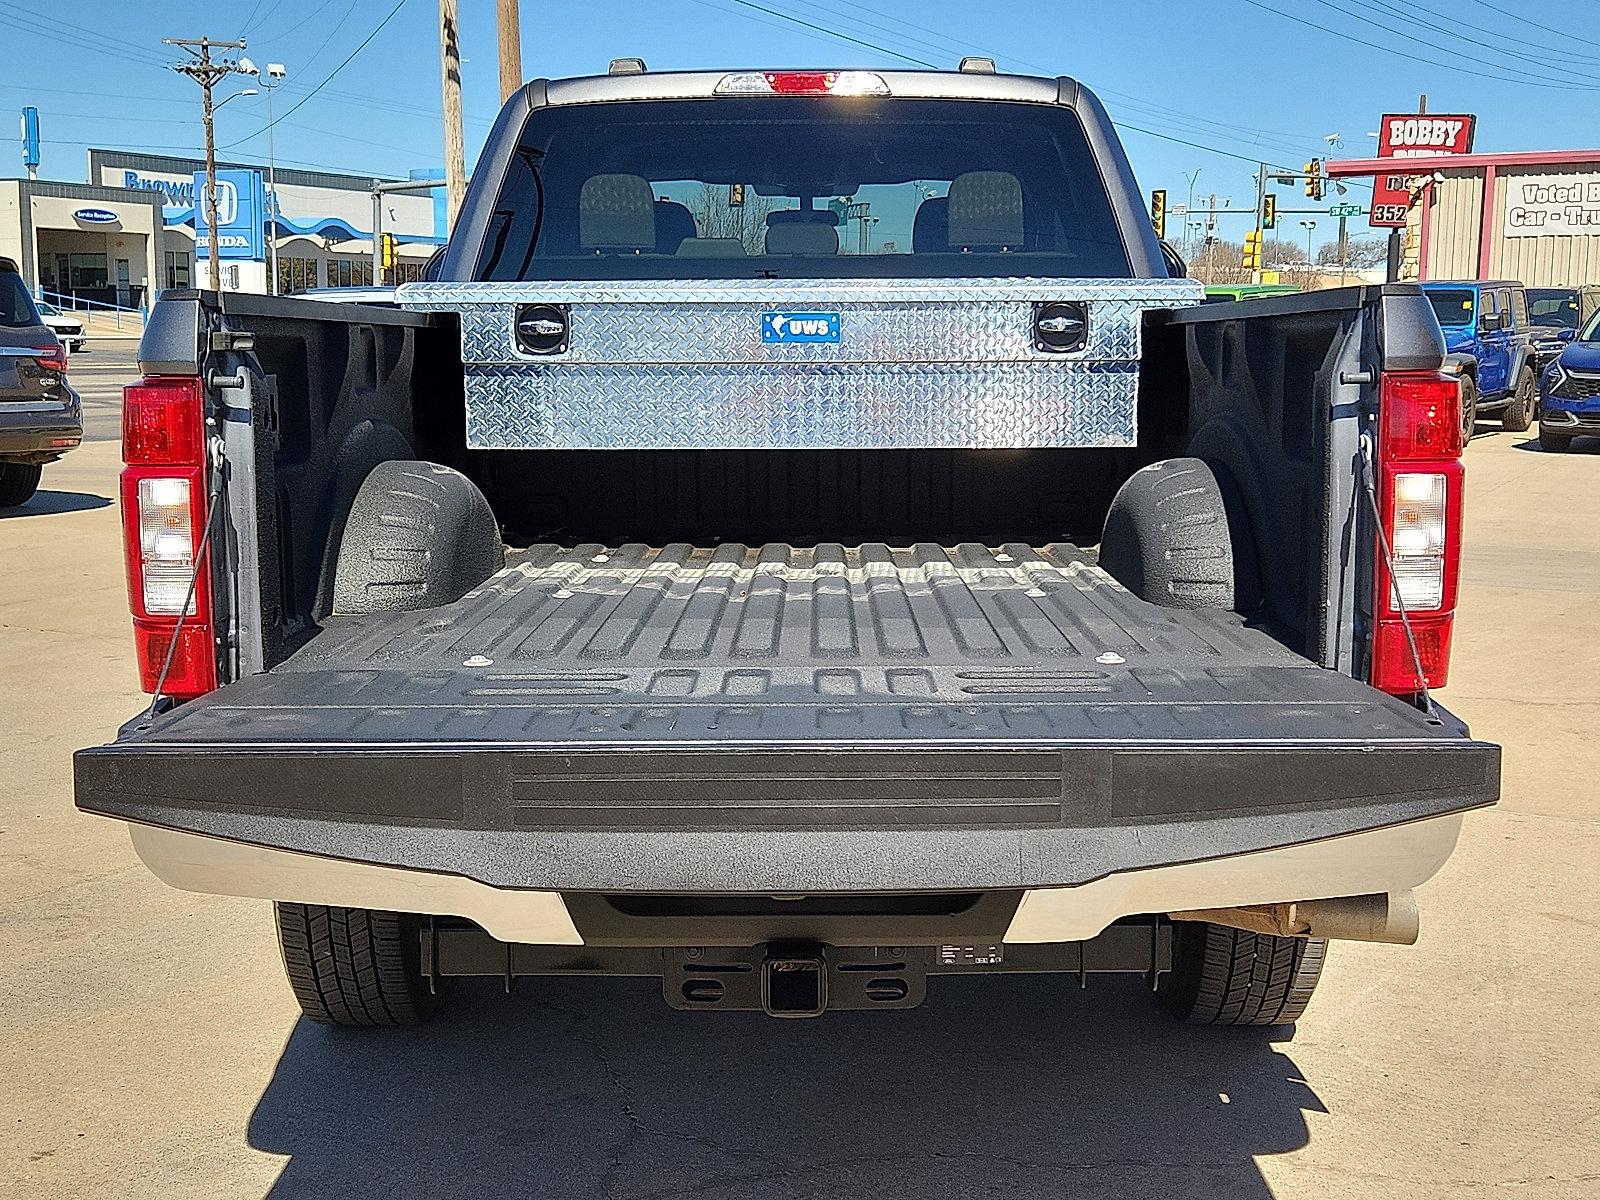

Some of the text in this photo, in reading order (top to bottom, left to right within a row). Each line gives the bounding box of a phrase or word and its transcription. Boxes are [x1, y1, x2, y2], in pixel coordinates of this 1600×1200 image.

[1389, 120, 1463, 147] BOBBY
[1522, 183, 1583, 204] Voted
[1374, 205, 1407, 222] 352
[1510, 207, 1547, 227] Car
[204, 266, 236, 275] SVIC
[789, 320, 829, 336] UWS
